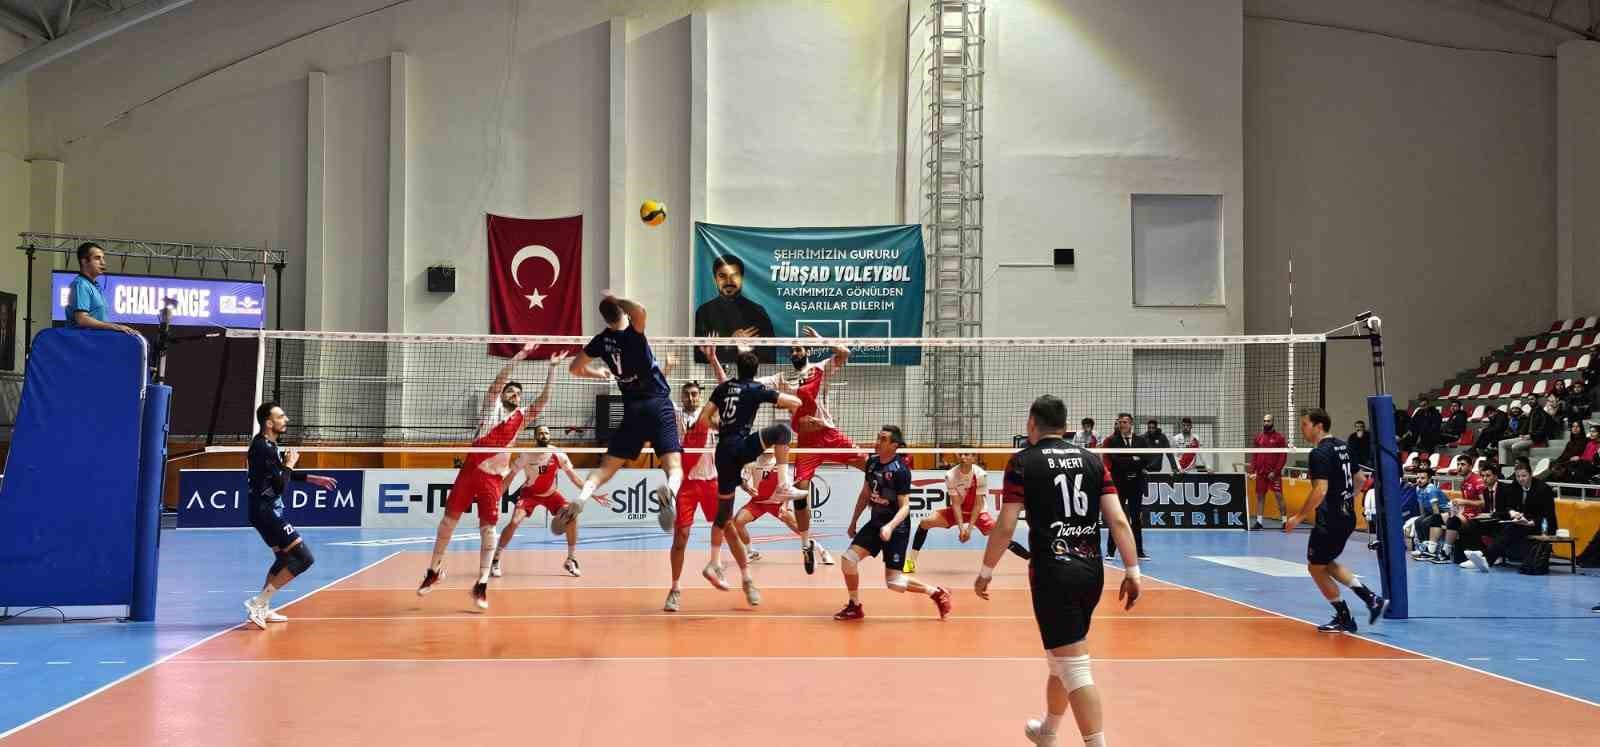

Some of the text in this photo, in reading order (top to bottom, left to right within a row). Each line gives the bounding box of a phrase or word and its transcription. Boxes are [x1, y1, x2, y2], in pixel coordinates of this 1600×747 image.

[774, 248, 900, 261] ŞEHRİMİZİN GURURU
[769, 262, 911, 285] TÜRŞAD VOLEYBOL
[777, 286, 904, 297] TAKIMIMIZA GÖNÜLDEN
[785, 300, 895, 312] BAŞARILAR DİLERİM
[186, 490, 355, 509] ACIDEM
[611, 478, 661, 513] SMS
[1054, 473, 1089, 517] 16
[1141, 482, 1232, 506] UNUS
